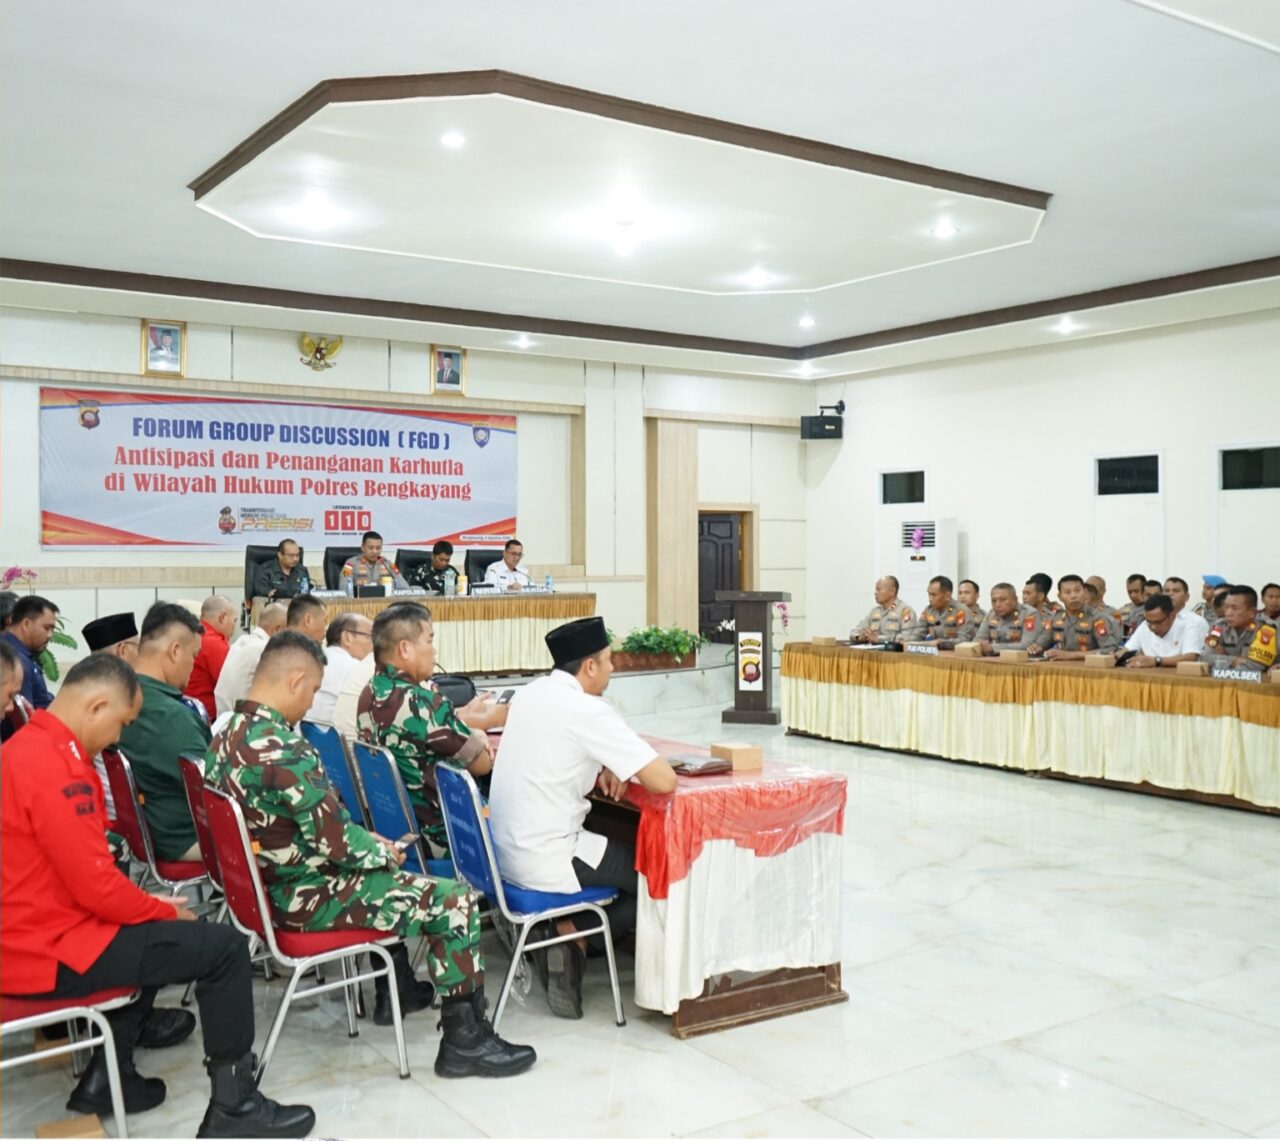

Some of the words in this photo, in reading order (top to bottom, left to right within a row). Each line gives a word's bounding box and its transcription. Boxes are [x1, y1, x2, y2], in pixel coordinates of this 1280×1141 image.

[133, 417, 203, 439] FORUM
[209, 421, 275, 442] GROUP
[279, 425, 390, 447] DISCUSSION
[114, 446, 215, 469] Antisipasi
[222, 450, 260, 469] dan
[266, 452, 384, 474] Penanganan
[389, 457, 464, 476] Karhutla
[104, 472, 125, 491] di
[133, 473, 217, 495] Wilayah
[224, 475, 294, 495] Hukum
[300, 477, 358, 497] Polres
[364, 479, 471, 501] Bengkayang
[1214, 669, 1258, 680] KAPOLSEK
